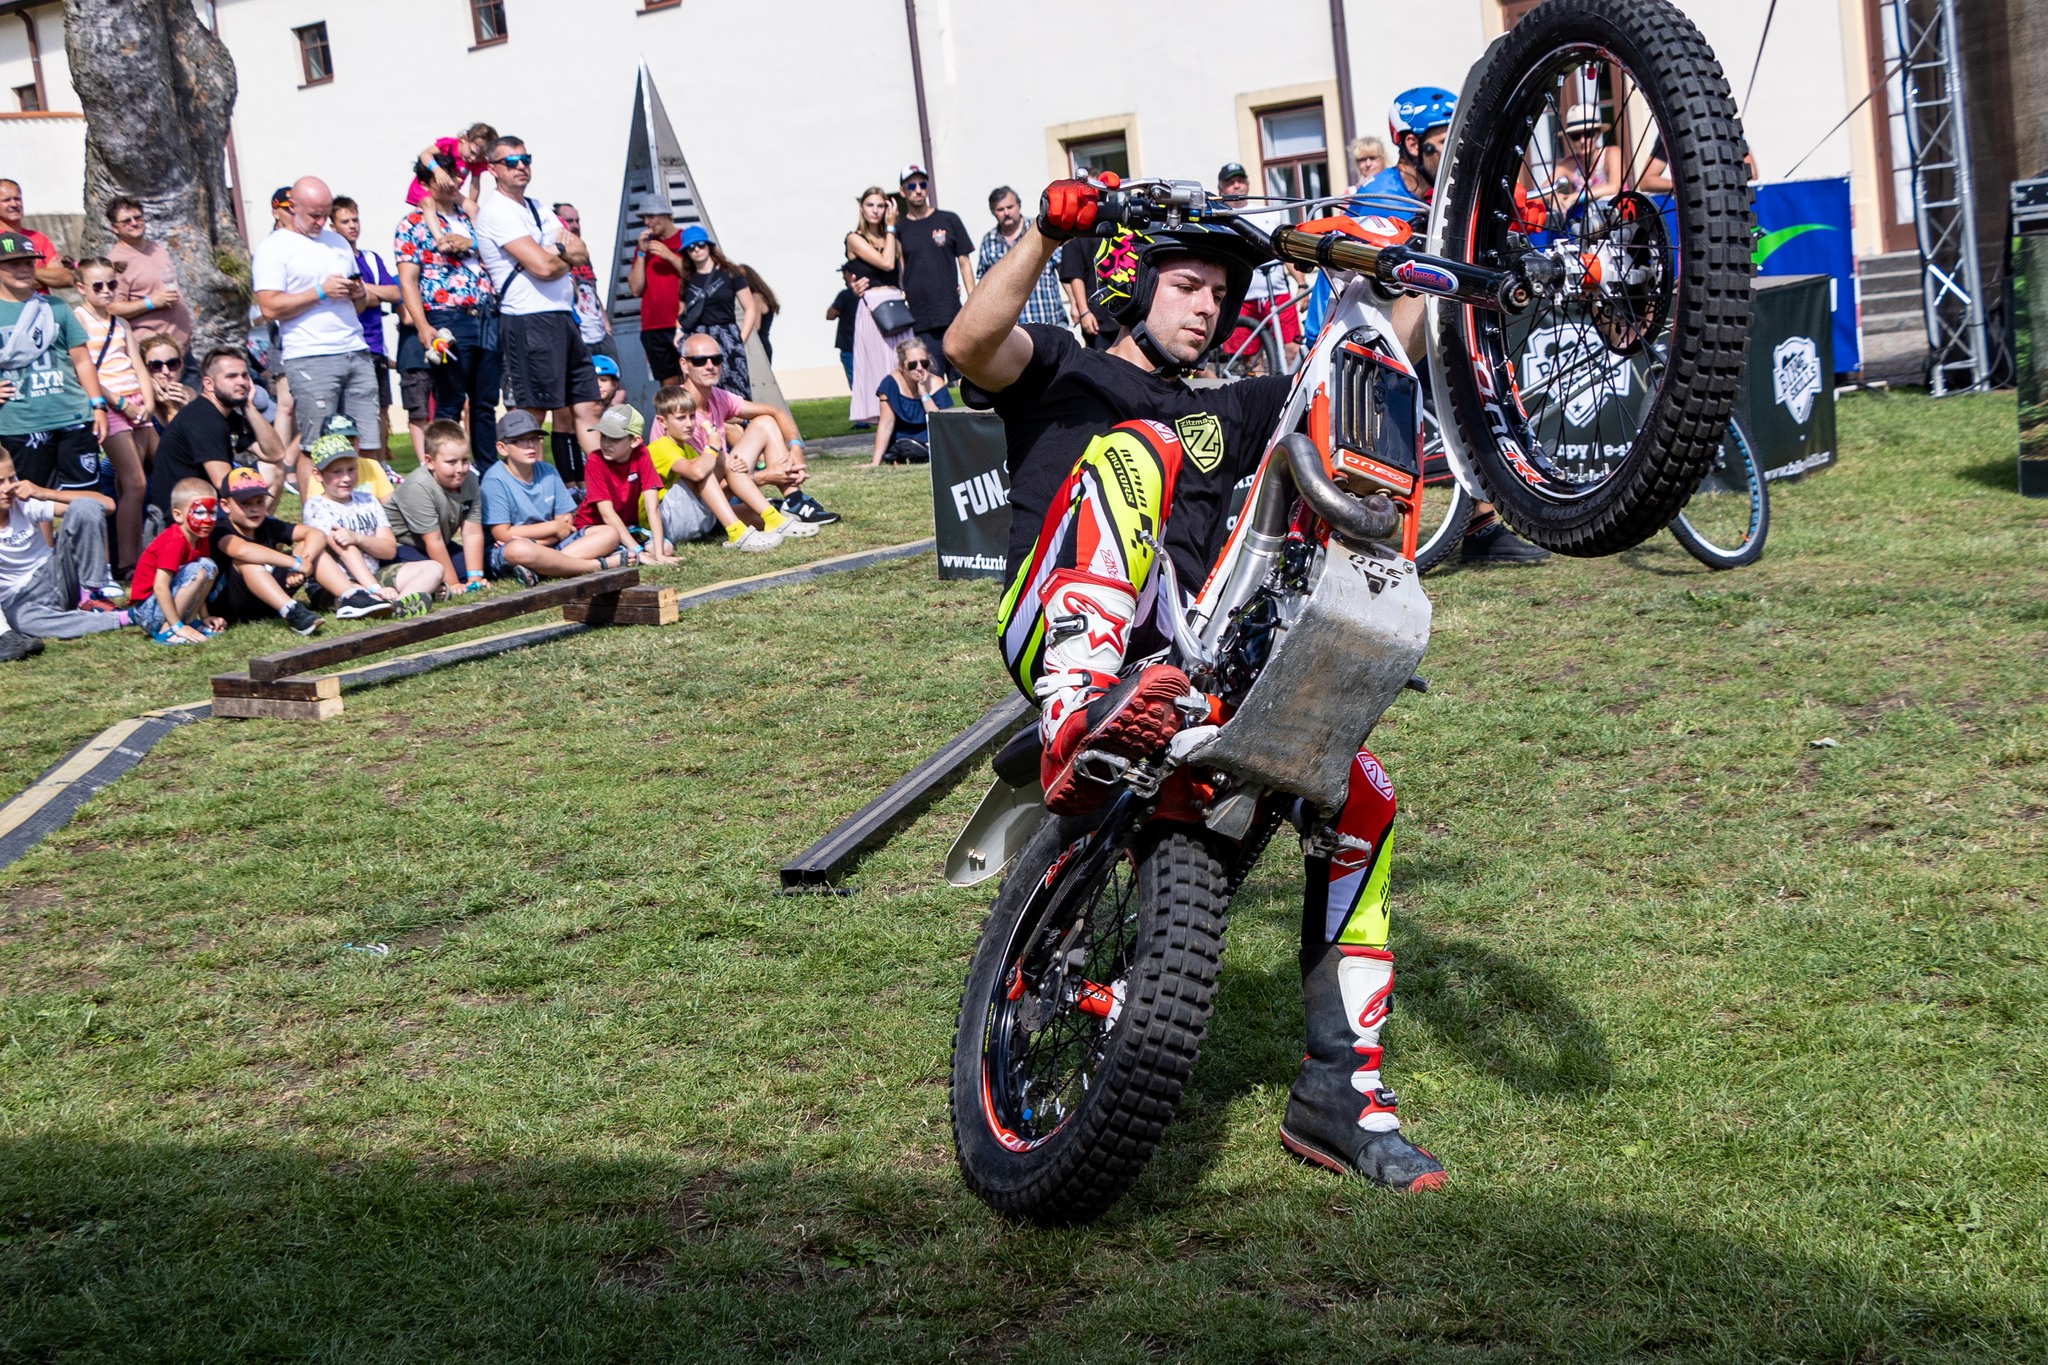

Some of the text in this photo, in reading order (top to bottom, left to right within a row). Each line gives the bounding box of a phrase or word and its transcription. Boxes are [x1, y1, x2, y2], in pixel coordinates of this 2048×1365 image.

[1107, 450, 1135, 505] MOTORS
[1119, 448, 1147, 508] ALPHA
[1082, 988, 1107, 1002] TRS
